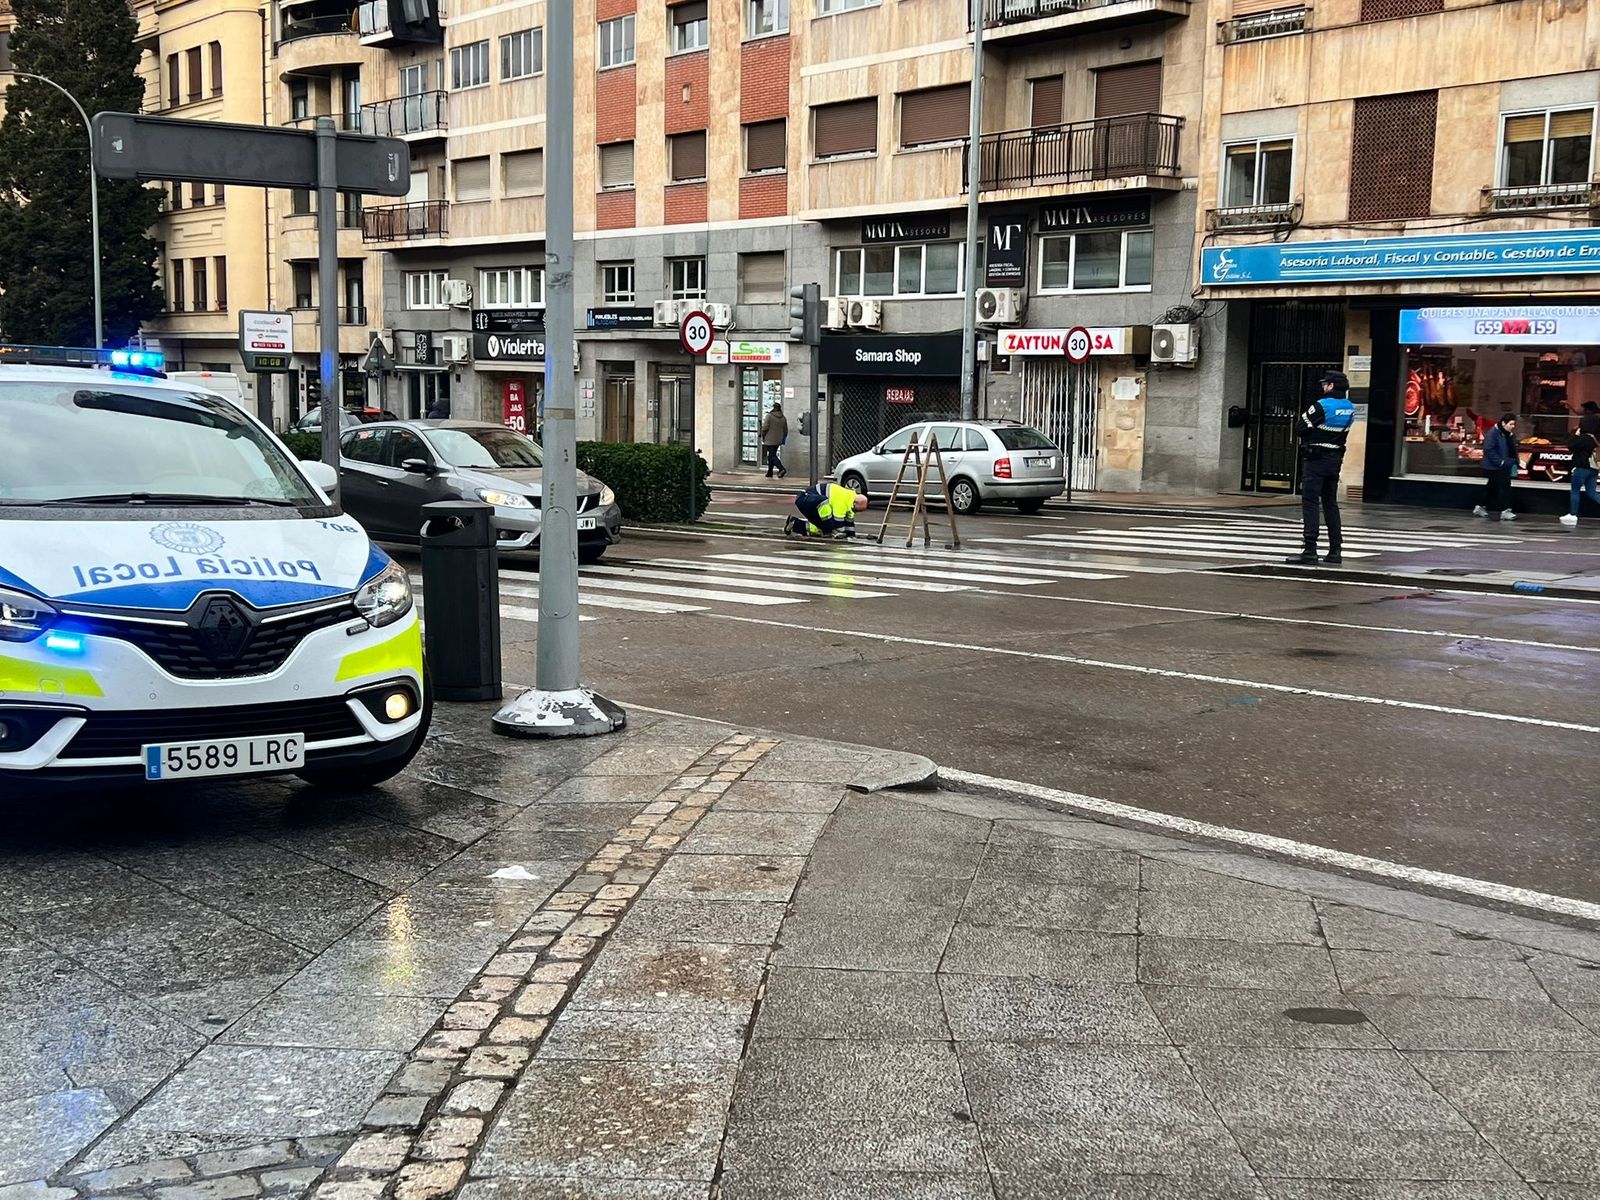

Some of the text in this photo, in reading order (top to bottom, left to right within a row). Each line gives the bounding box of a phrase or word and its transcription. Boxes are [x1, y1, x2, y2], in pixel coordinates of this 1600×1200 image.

[1093, 211, 1146, 223] ASESORES
[905, 226, 947, 237] ASESORES
[1279, 255, 1328, 268] Asesoría
[1331, 252, 1381, 267] Laboral,
[1384, 252, 1421, 264] Fiscal
[1422, 254, 1431, 265] y
[1434, 249, 1498, 262] Contable.
[1502, 246, 1555, 259] Gestión
[1557, 246, 1576, 257] de
[1417, 308, 1463, 320] ¿QUIERES
[1468, 308, 1490, 318] UNA
[1493, 307, 1548, 318] PANTALLA
[1549, 307, 1584, 317] COMO
[689, 326, 706, 340] 30
[500, 338, 545, 355] Violetta
[1008, 334, 1113, 350] ZAYTUN SA
[1071, 338, 1086, 351] 30
[855, 348, 922, 366] Samara Shop
[509, 393, 519, 401] BA
[886, 388, 914, 402] REBAJAS
[510, 404, 522, 412] JAS
[315, 519, 359, 533] 708
[167, 738, 298, 772] 5589 LRC
